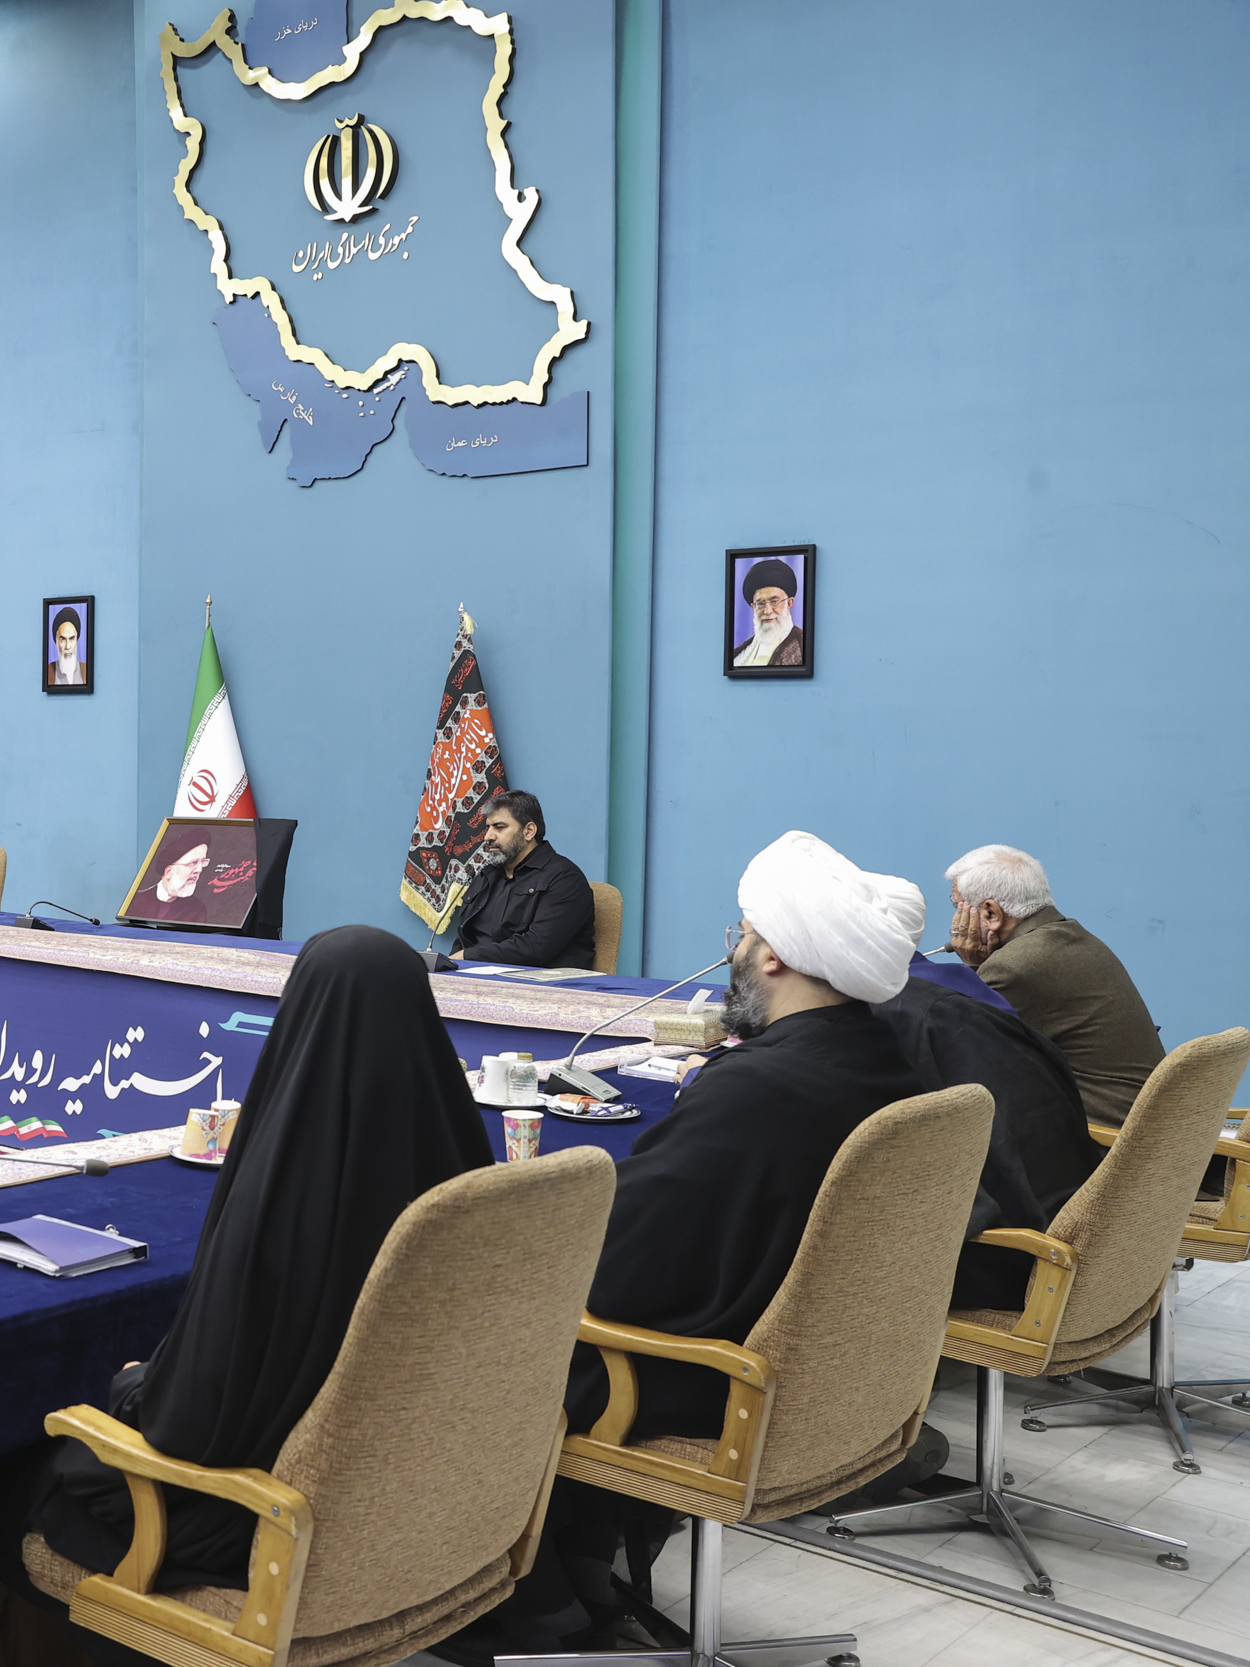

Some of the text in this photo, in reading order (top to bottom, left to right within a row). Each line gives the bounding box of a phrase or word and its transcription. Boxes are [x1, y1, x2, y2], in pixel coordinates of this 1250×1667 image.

[274, 17, 318, 42] دریای خزر
[292, 215, 419, 281] جمهوری اسلامی ایران
[271, 379, 314, 426] خلیج فارس
[445, 433, 498, 452] دریای عمان
[58, 1020, 223, 1116] اختتامیه
